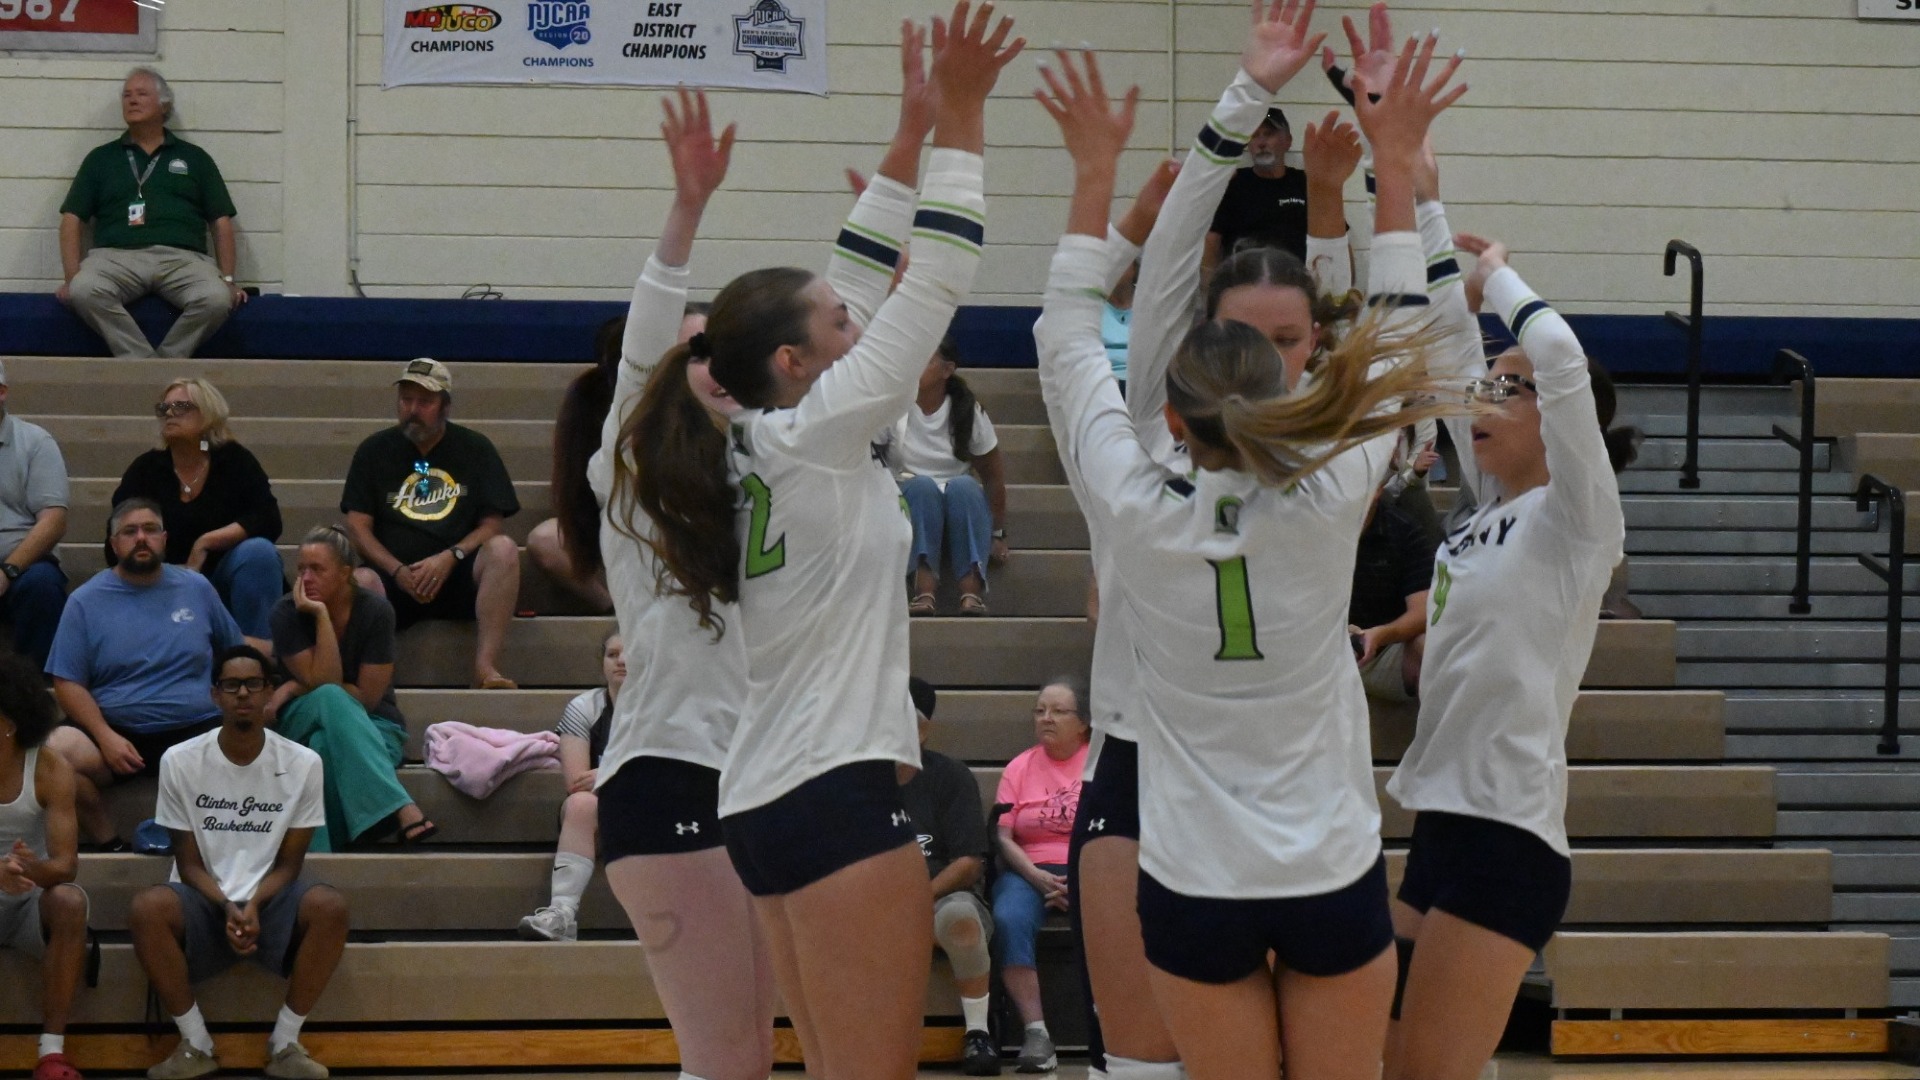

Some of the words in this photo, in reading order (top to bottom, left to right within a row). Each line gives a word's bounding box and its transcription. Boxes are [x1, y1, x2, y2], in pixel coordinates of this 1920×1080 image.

[528, 3, 590, 31] NJCAA
[648, 2, 682, 17] EAST
[573, 31, 589, 40] 20
[633, 23, 697, 38] DISTRICT
[411, 40, 494, 52] CHAMPIONS
[742, 35, 797, 47] CHAMPIONSHIP
[622, 43, 707, 59] CHAMPIONS
[522, 57, 594, 67] CHAMPIONS
[1204, 555, 1265, 661] 1
[195, 794, 238, 811] Clinton
[238, 796, 284, 817] Grace
[202, 816, 273, 833] Basketball
